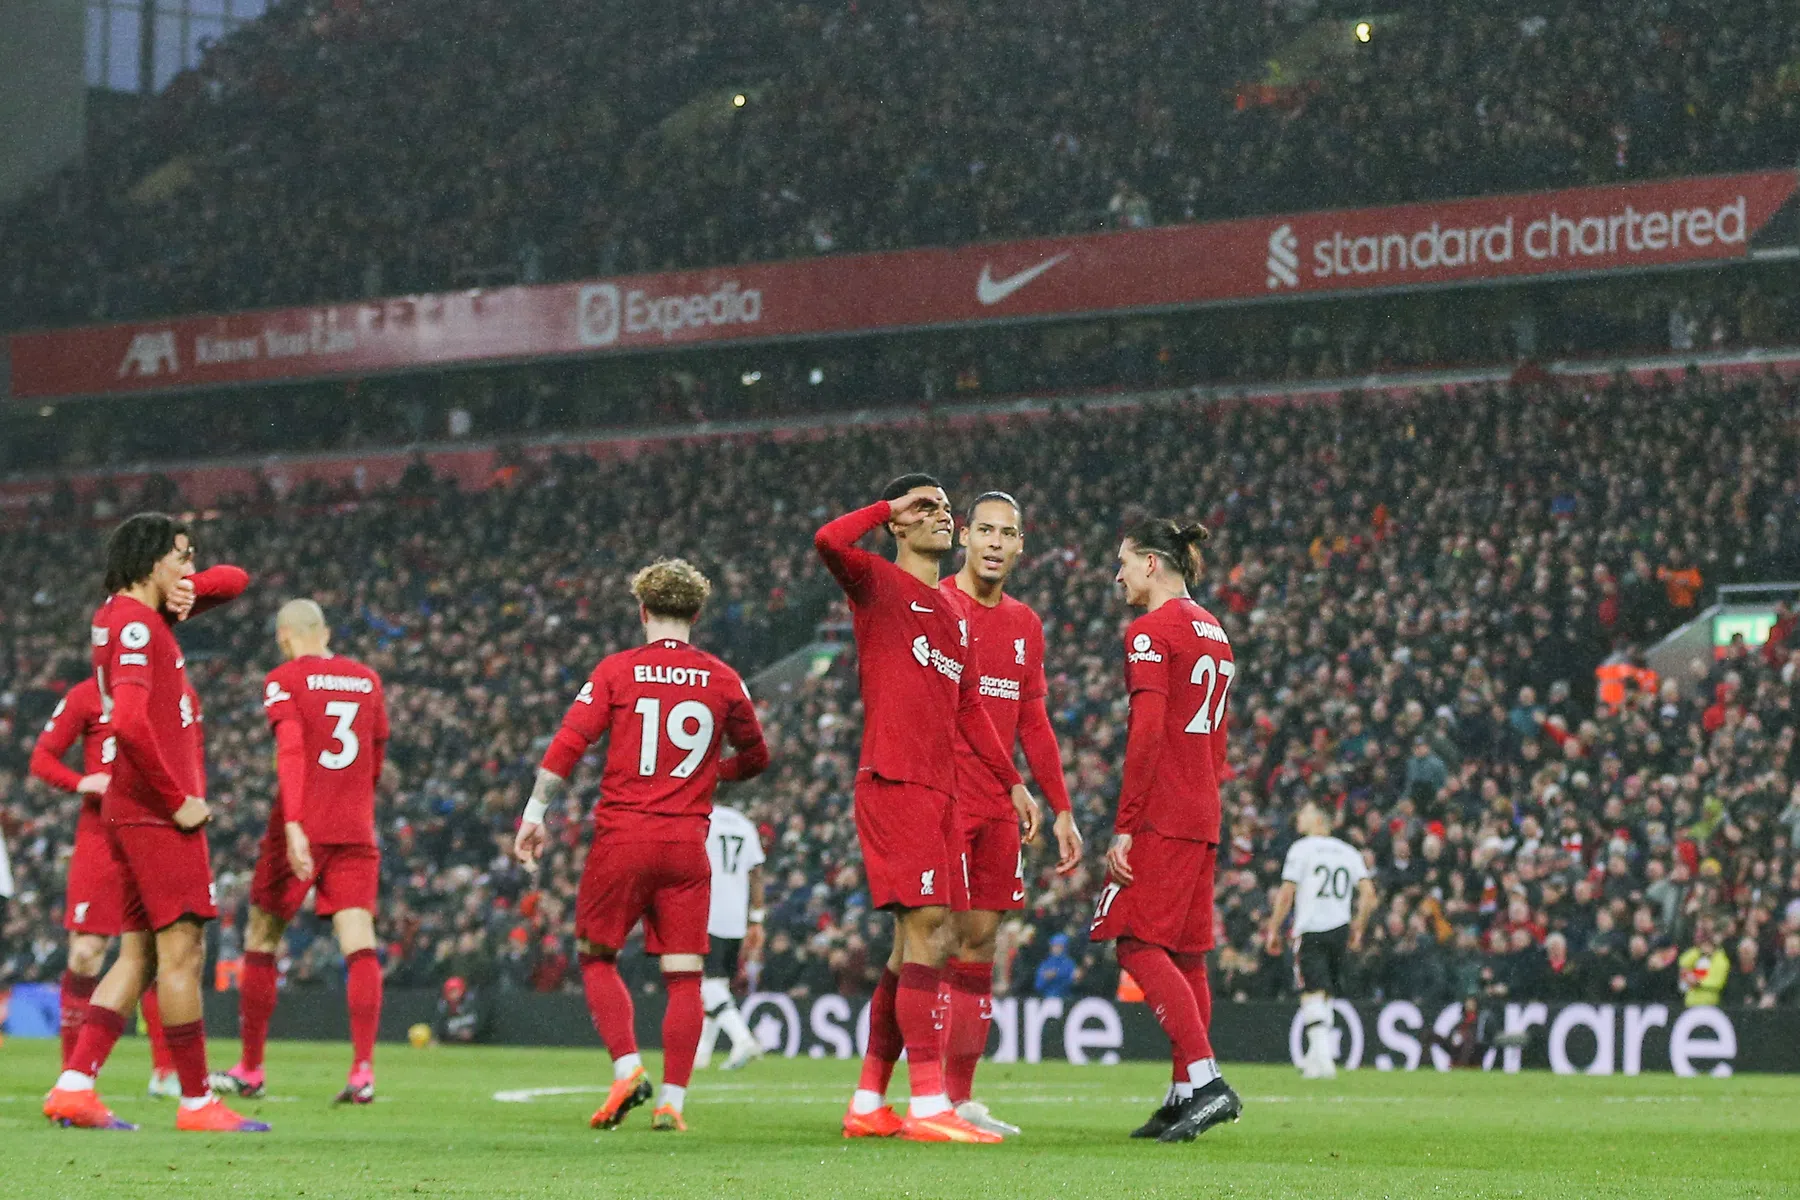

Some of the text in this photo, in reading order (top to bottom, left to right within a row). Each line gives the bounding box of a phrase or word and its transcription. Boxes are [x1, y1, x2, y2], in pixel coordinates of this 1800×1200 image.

[1313, 196, 1747, 278] standard chartered
[626, 281, 762, 341] Expedia
[306, 674, 374, 694] FABINHO
[634, 665, 711, 688] ELLIOTT
[1184, 654, 1236, 734] 27
[318, 701, 360, 770] 3
[634, 697, 714, 778] 19
[718, 834, 744, 874] 17
[1314, 865, 1350, 899] 20
